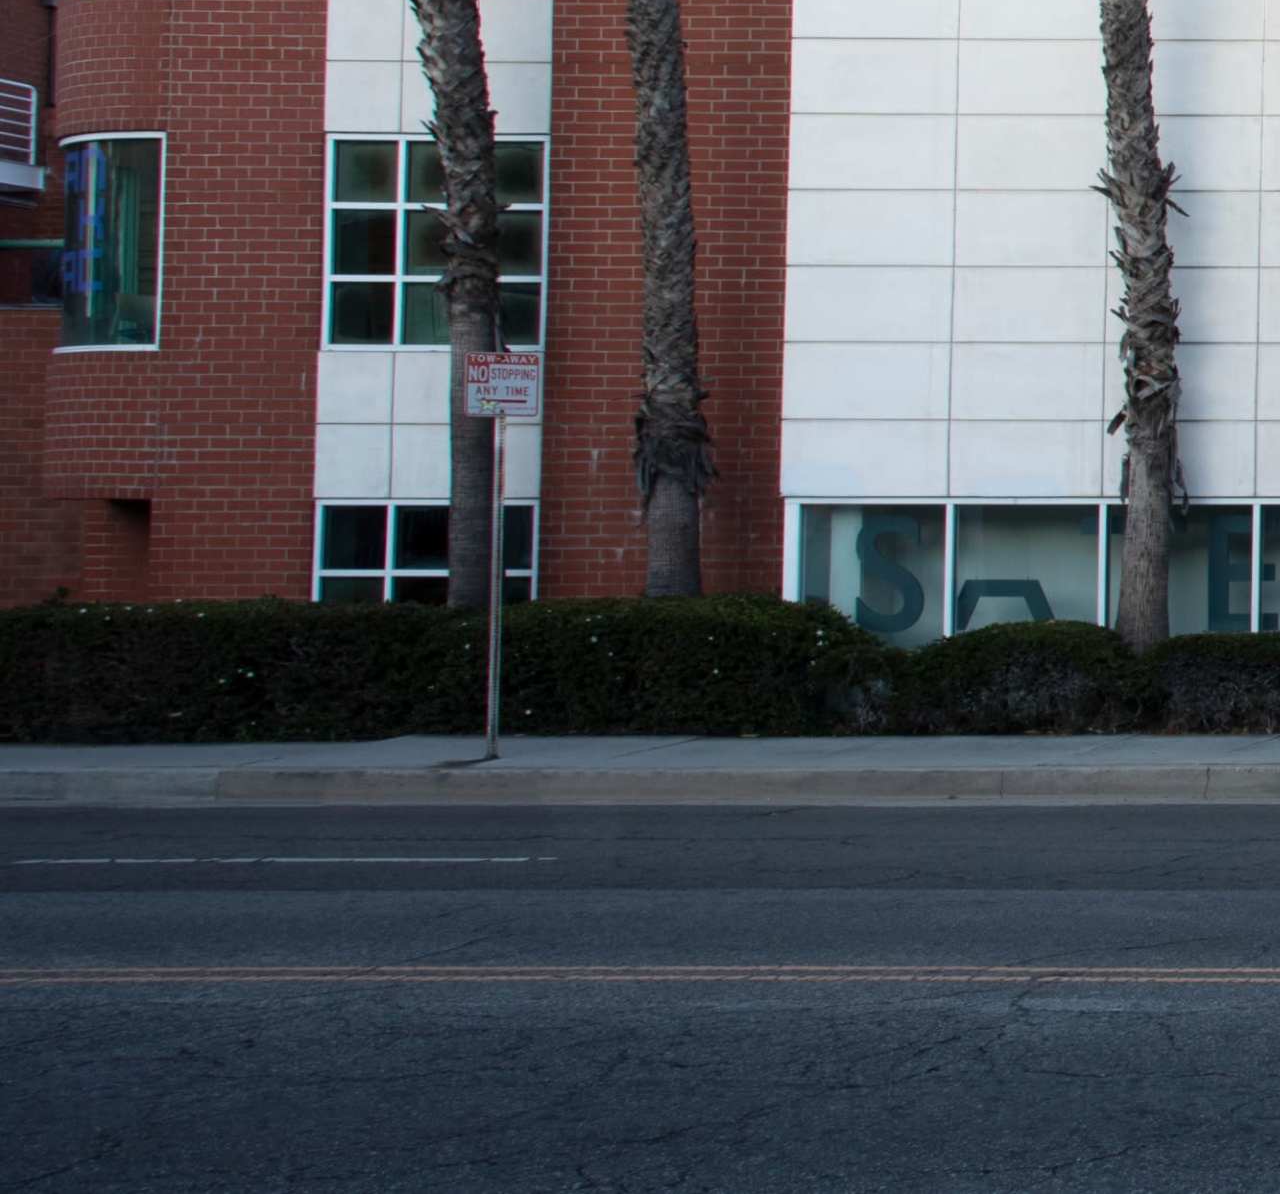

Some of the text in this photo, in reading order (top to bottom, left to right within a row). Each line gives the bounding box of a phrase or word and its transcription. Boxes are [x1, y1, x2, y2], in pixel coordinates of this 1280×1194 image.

[469, 354, 537, 364] TOW-AWAY
[468, 365, 537, 382] NO STOPPING
[476, 386, 529, 397] ANY TIME
